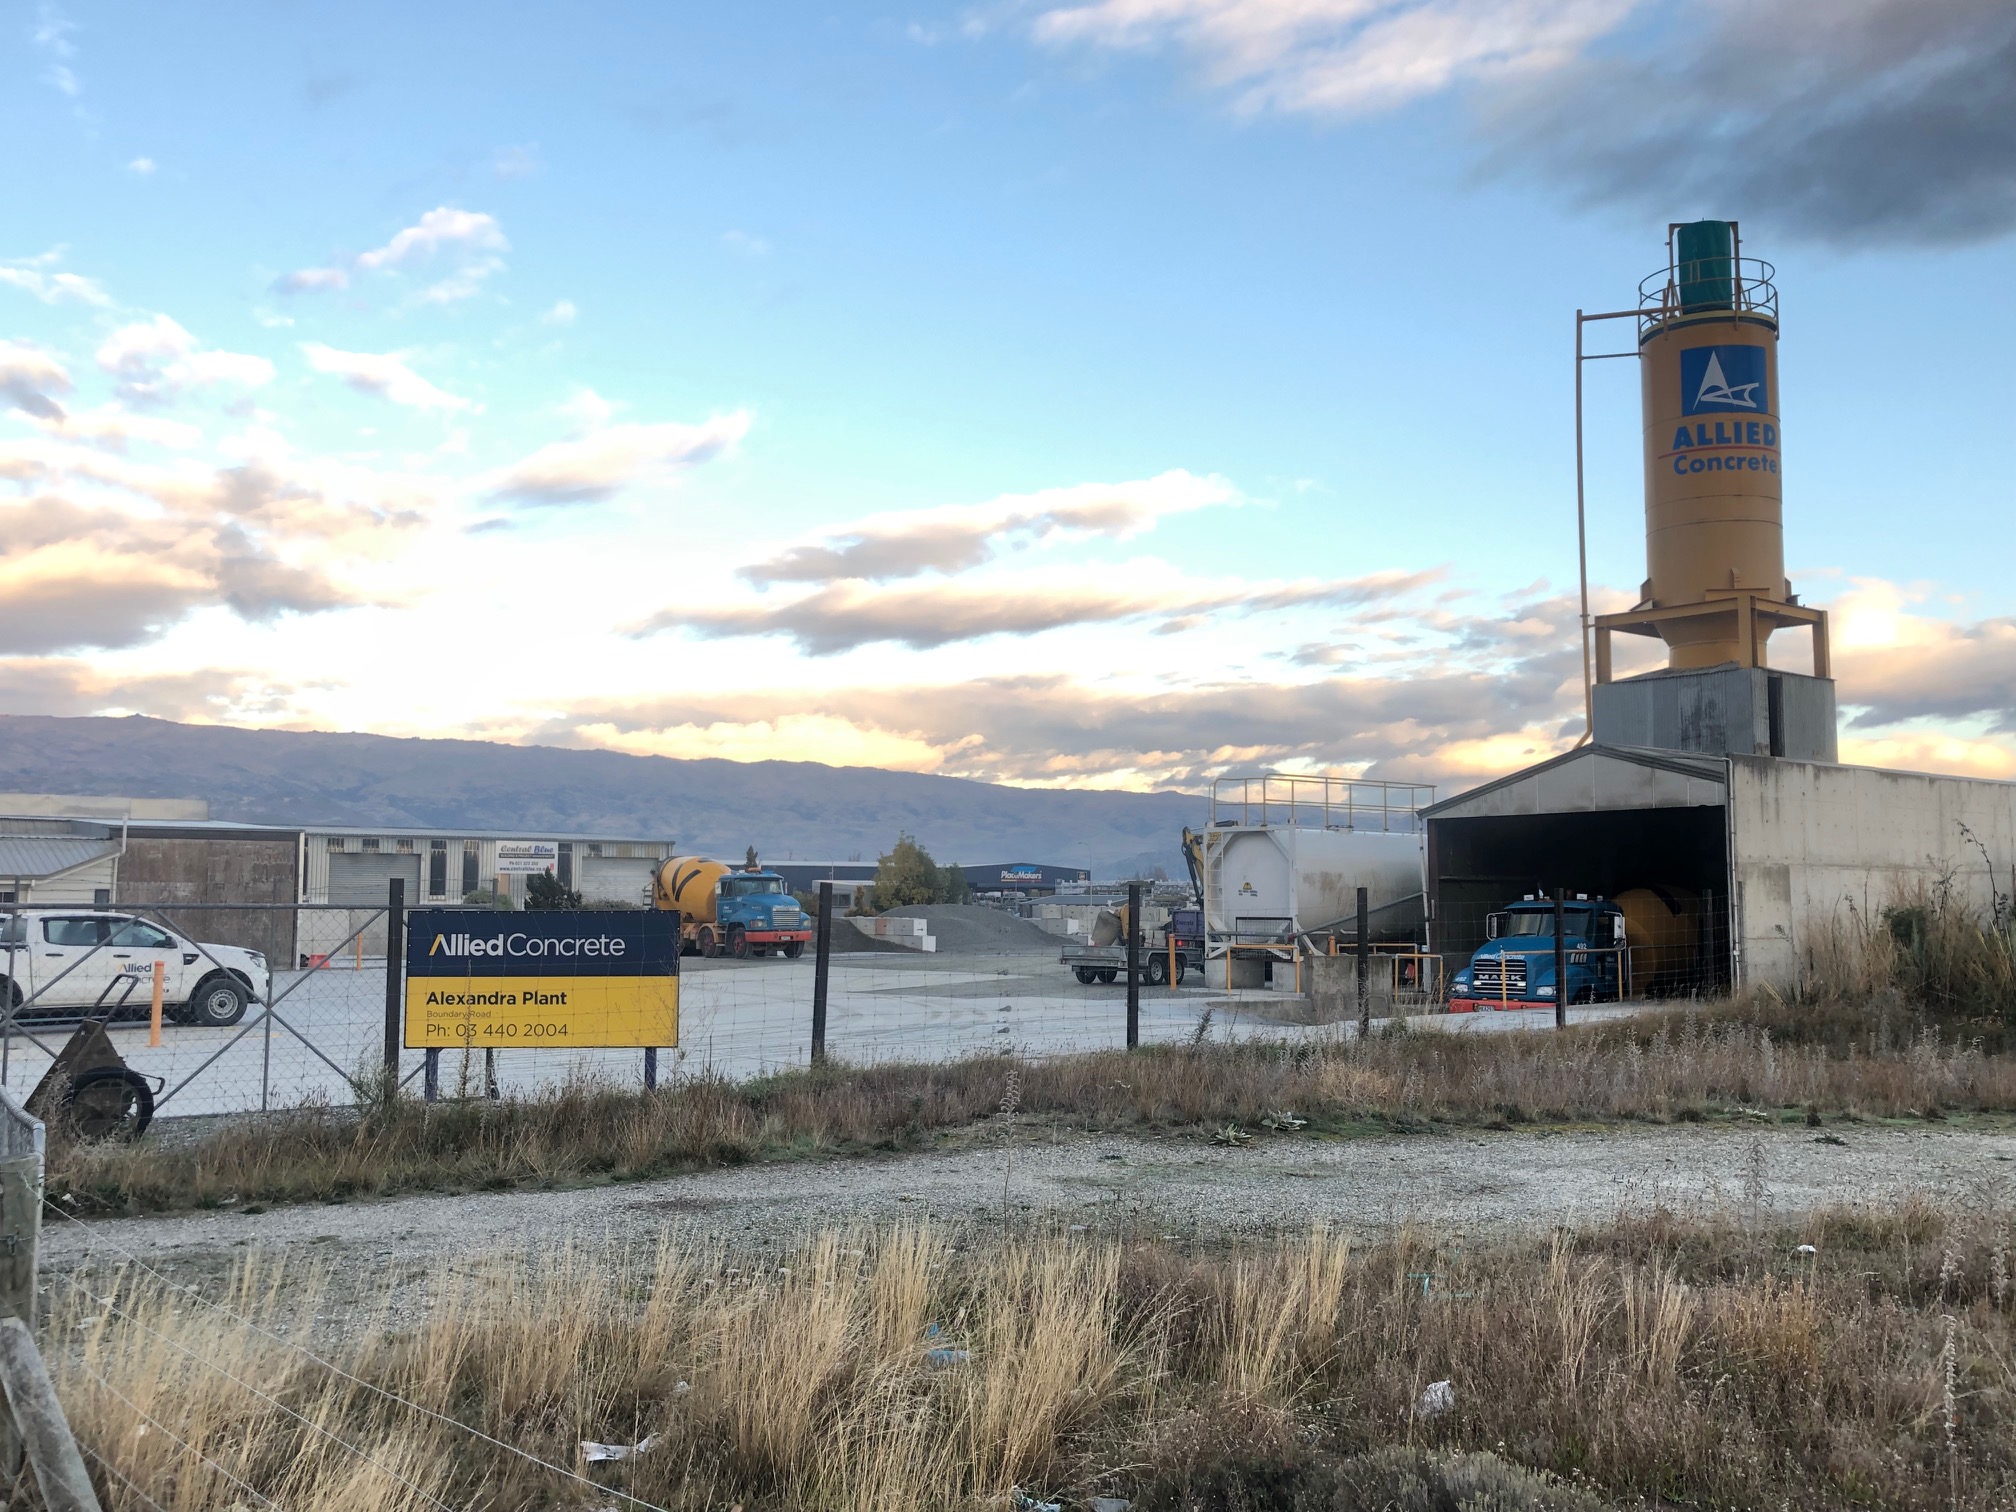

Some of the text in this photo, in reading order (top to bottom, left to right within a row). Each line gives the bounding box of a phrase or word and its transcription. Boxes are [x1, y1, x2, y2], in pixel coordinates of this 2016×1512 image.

[1672, 422, 1776, 451] ALLIED
[1673, 454, 1777, 475] Concrete
[500, 845, 554, 854] Central Blue
[1001, 870, 1042, 880] PlaceMakers
[1576, 942, 1588, 950] 492
[118, 962, 152, 973] Allied
[426, 991, 567, 1006] Alexandra Plant
[426, 1010, 491, 1019] Boundary Road
[426, 1023, 569, 1037] Ph: 03 440 2004
